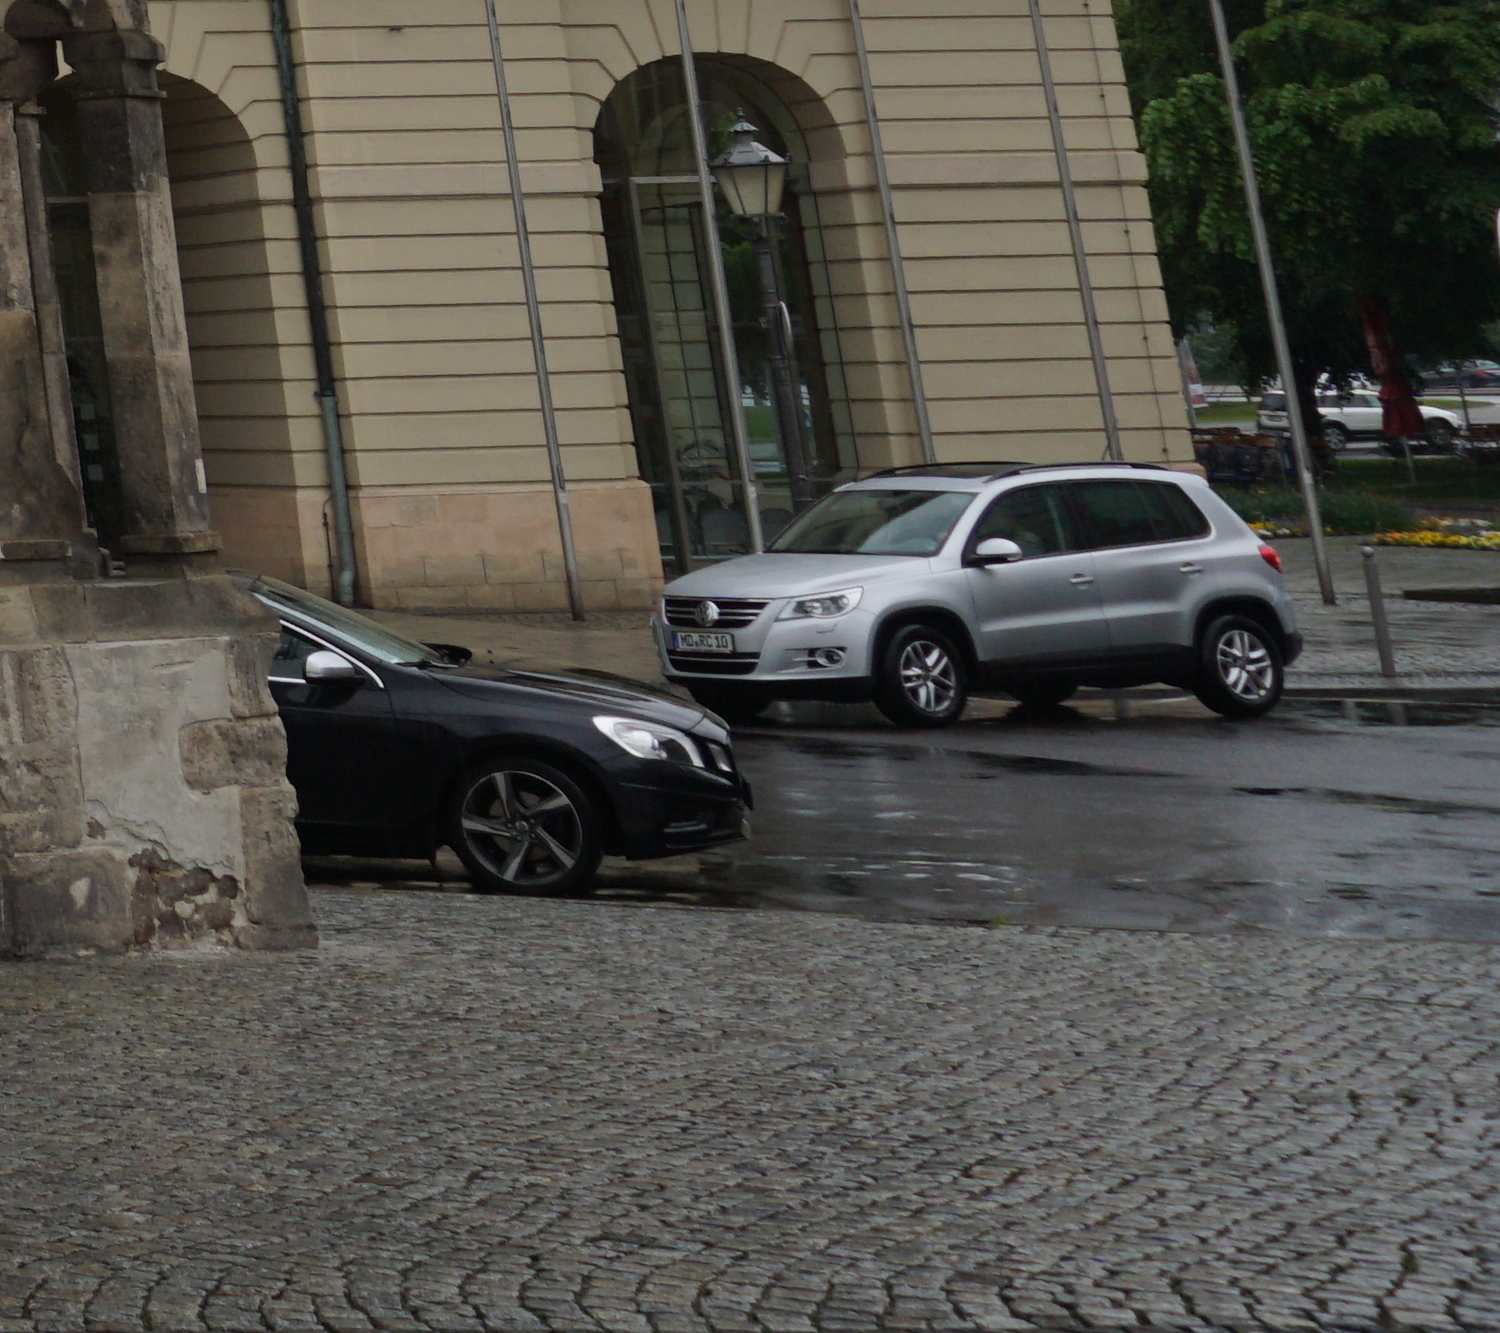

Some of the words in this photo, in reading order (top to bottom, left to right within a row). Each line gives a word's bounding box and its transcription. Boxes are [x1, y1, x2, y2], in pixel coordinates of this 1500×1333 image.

[680, 634, 694, 647] MD
[698, 635, 713, 648] RC
[714, 635, 729, 648] 10
